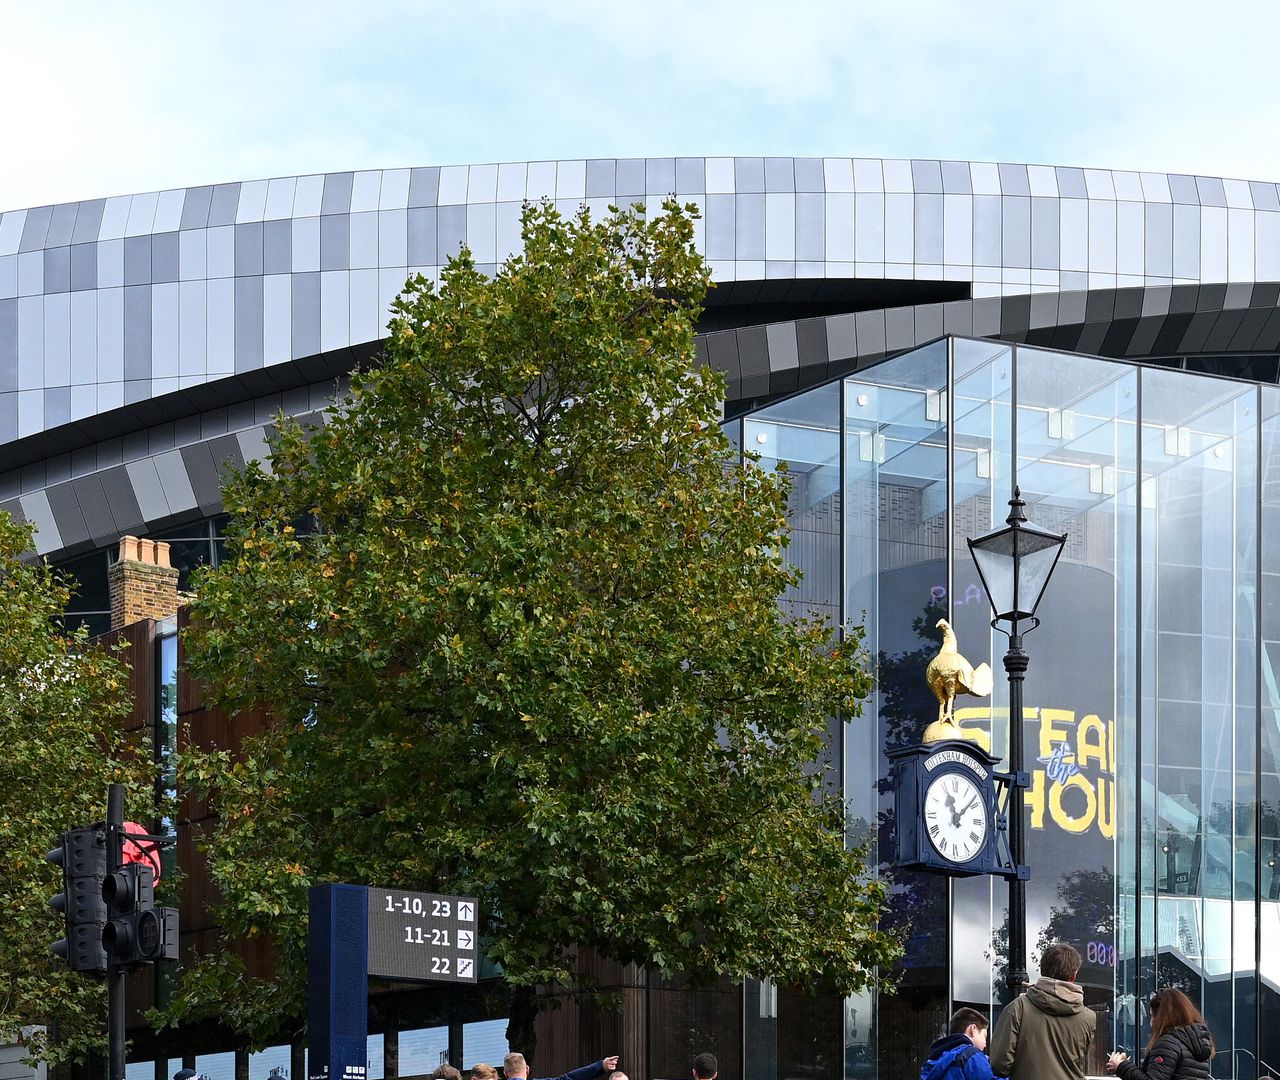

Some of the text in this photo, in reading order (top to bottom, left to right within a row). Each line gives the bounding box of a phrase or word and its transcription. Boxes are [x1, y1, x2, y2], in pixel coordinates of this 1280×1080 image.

[924, 751, 988, 780] TOTTENHAM HOTSPUR
[385, 895, 451, 918] 1-10, 23
[404, 926, 451, 947] 11-21
[431, 957, 451, 974] 22
